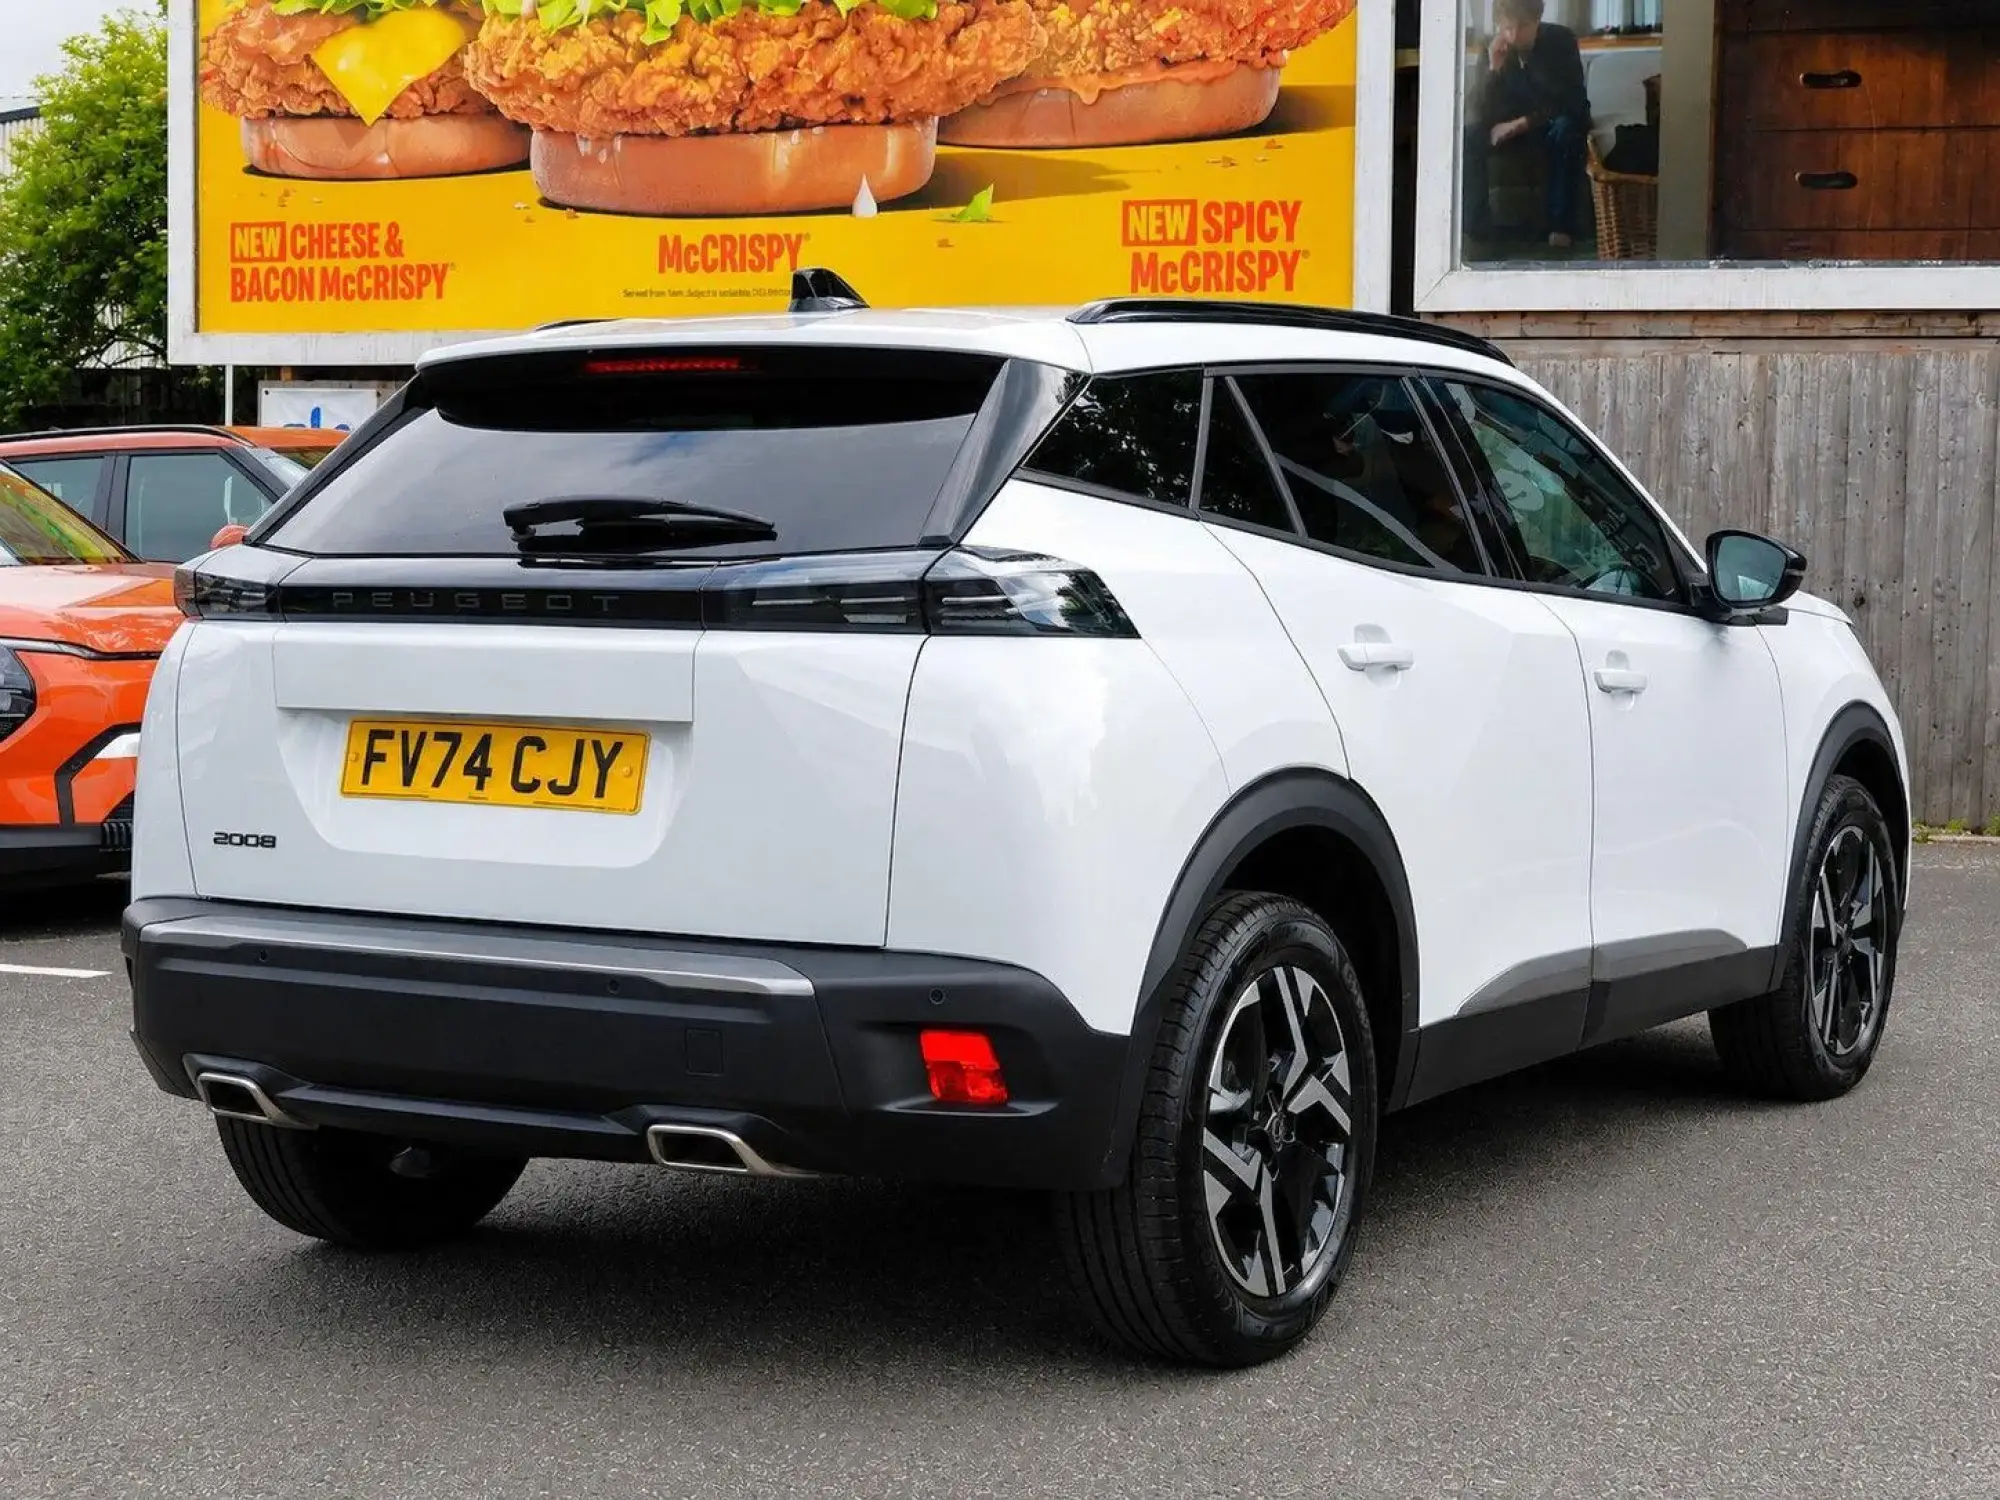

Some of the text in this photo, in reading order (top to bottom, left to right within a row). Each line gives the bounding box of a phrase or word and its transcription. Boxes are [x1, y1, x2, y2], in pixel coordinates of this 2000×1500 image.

[234, 221, 404, 260] NEW CHEESE &
[1128, 200, 1302, 244] NEW SPICY
[231, 266, 315, 303] BACON
[332, 591, 620, 612] PEUGEOT
[361, 728, 624, 799] FV74 CJY
[213, 832, 276, 848] 2008
